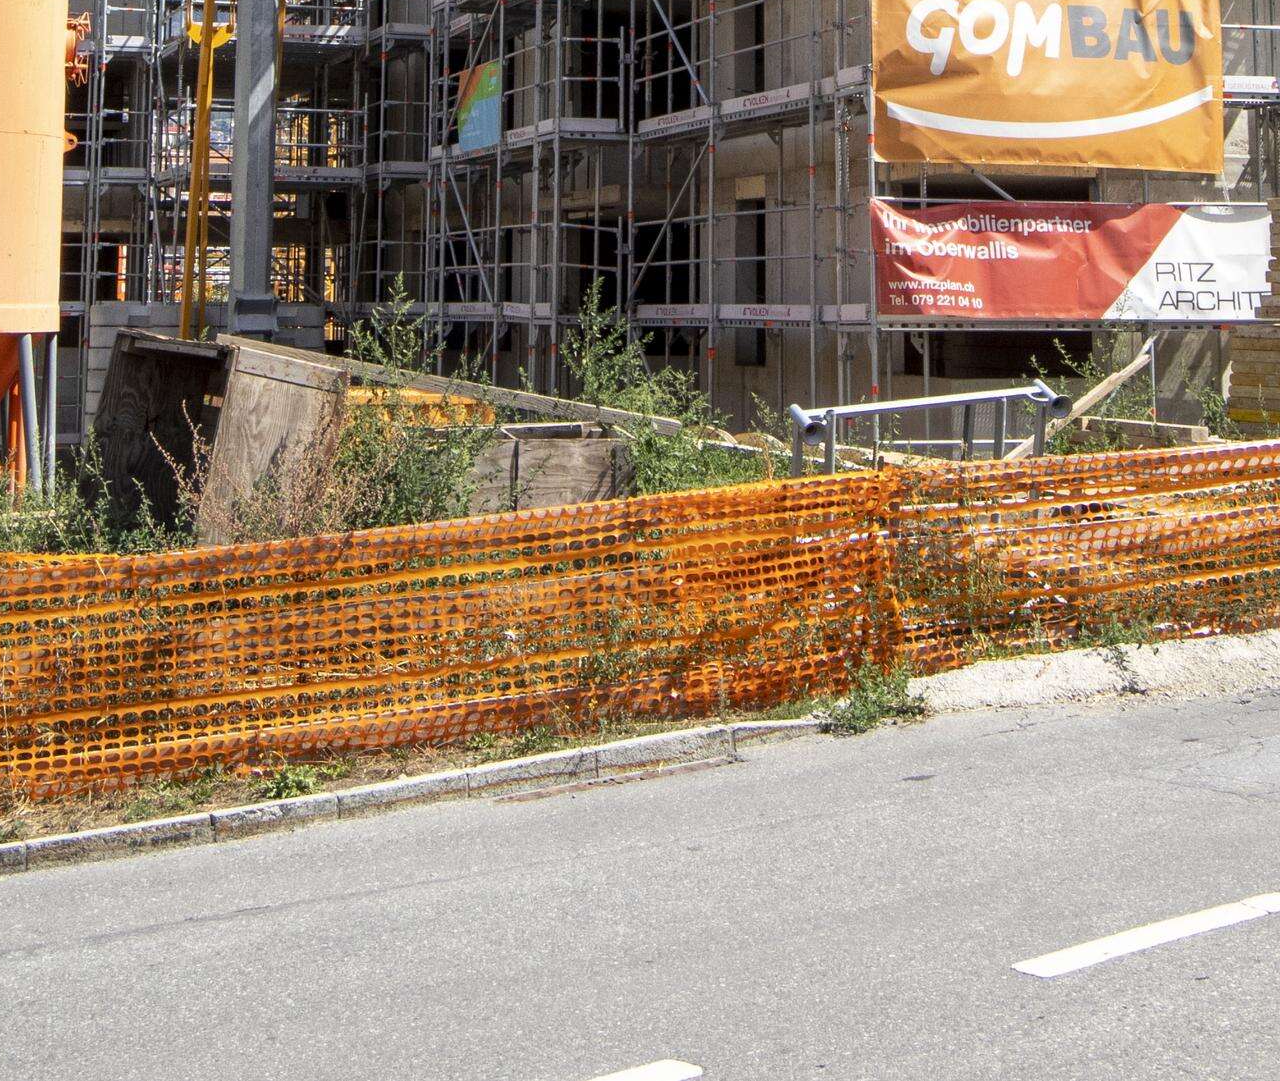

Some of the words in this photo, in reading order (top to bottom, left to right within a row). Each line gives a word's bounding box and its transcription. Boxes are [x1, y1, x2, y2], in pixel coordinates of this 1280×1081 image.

[917, 239, 1019, 260] Oberwallis
[1155, 262, 1216, 283] RITZ
[890, 295, 908, 306] Tel.
[911, 294, 933, 306] 079
[937, 294, 955, 306] 221
